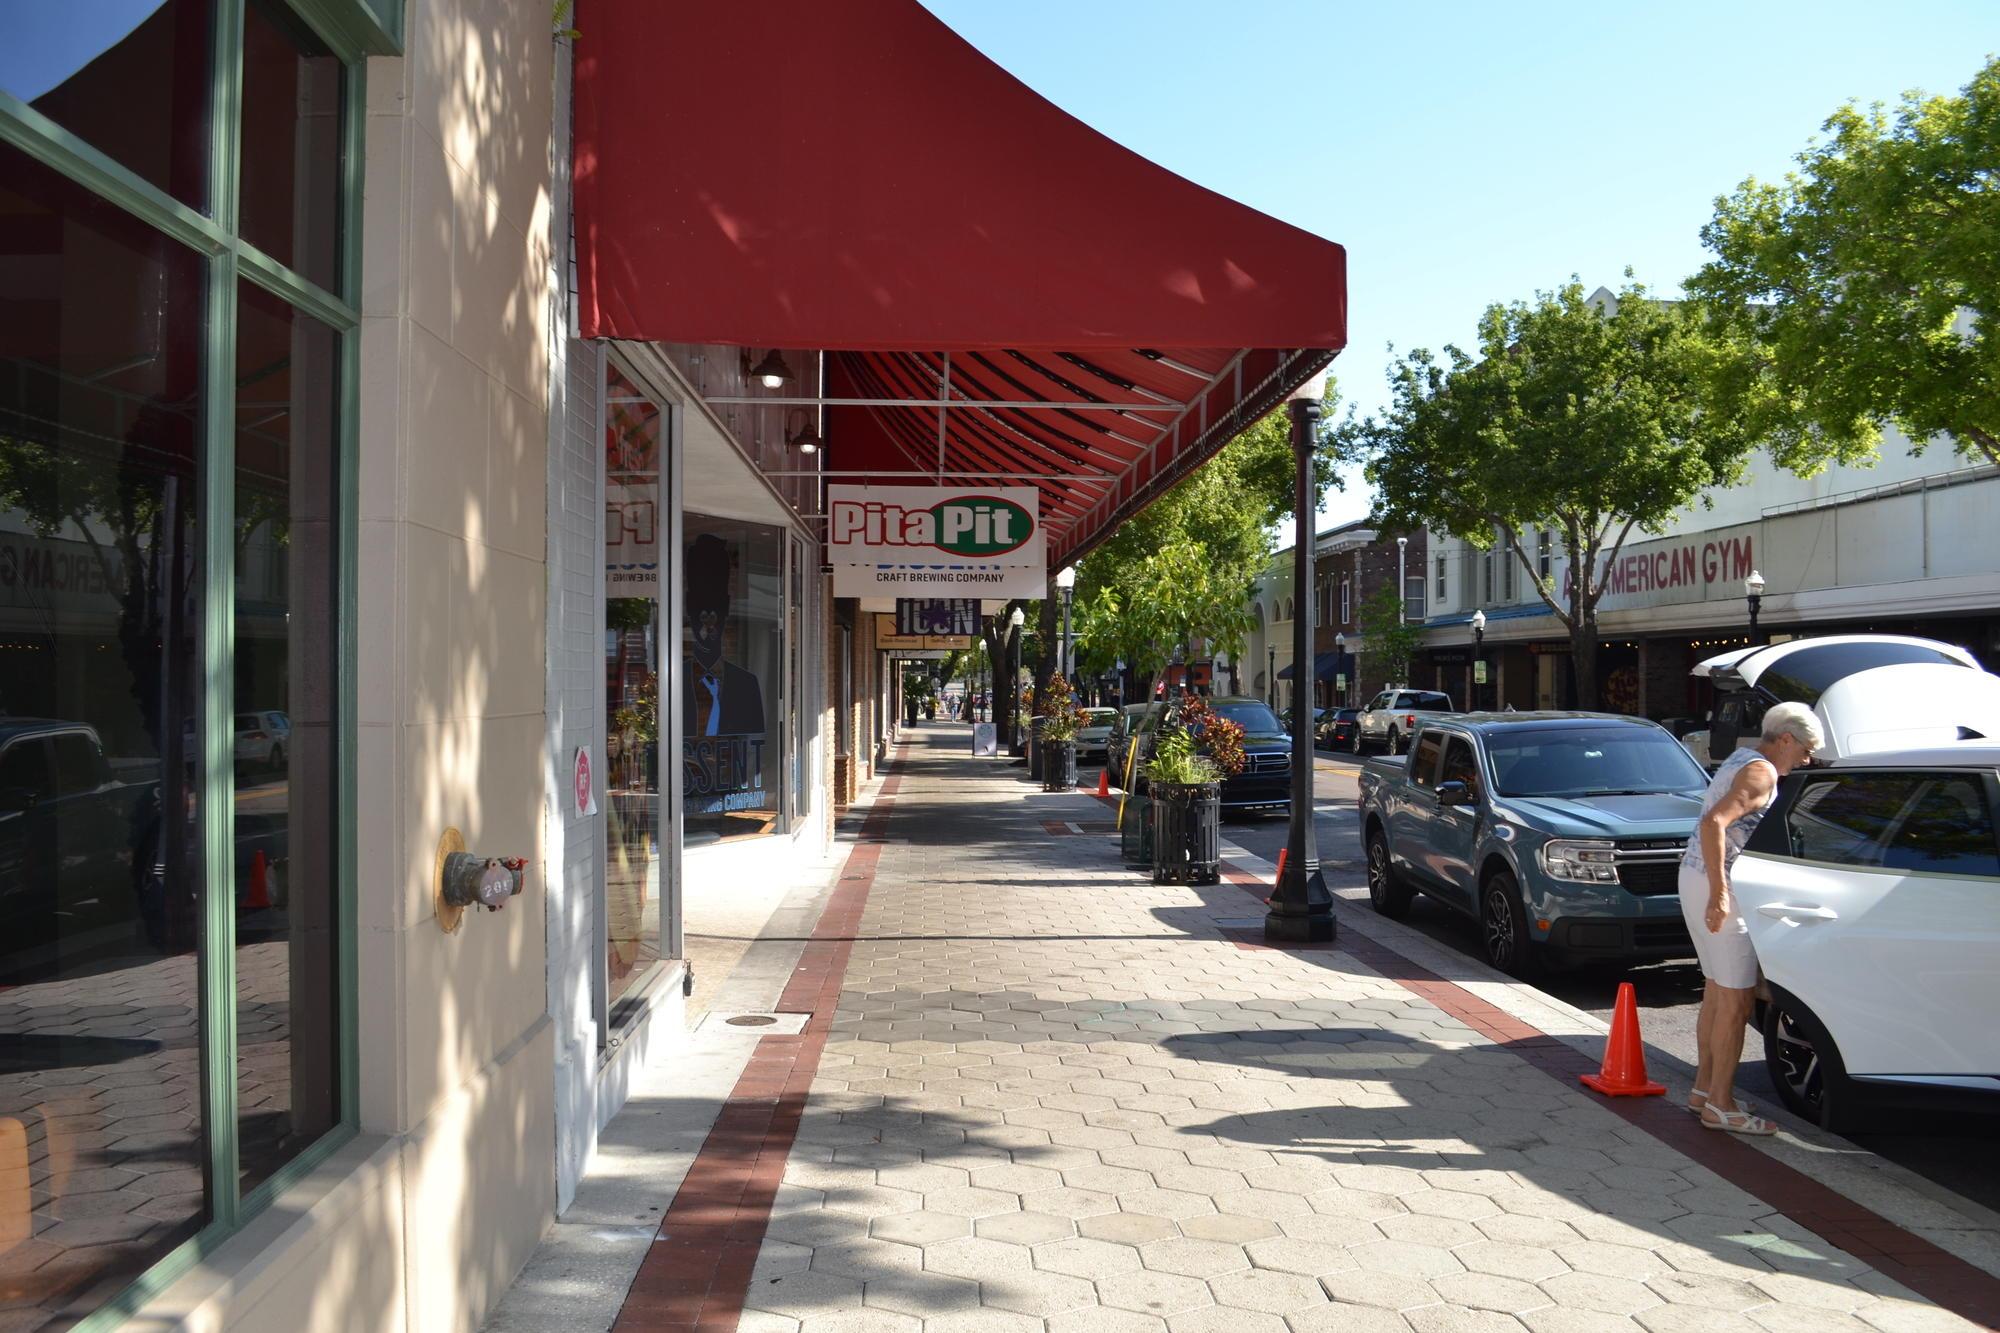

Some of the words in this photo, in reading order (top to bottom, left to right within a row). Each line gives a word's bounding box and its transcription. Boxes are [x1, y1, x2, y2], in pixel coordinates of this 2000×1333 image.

[832, 500, 935, 546] Pita
[943, 505, 1013, 544] Pit
[1702, 535, 1753, 583] GYM
[876, 572, 908, 583] CRAFT
[910, 572, 954, 583] BREWING
[956, 572, 1005, 583] COMPANY
[724, 790, 766, 810] COMPANY
